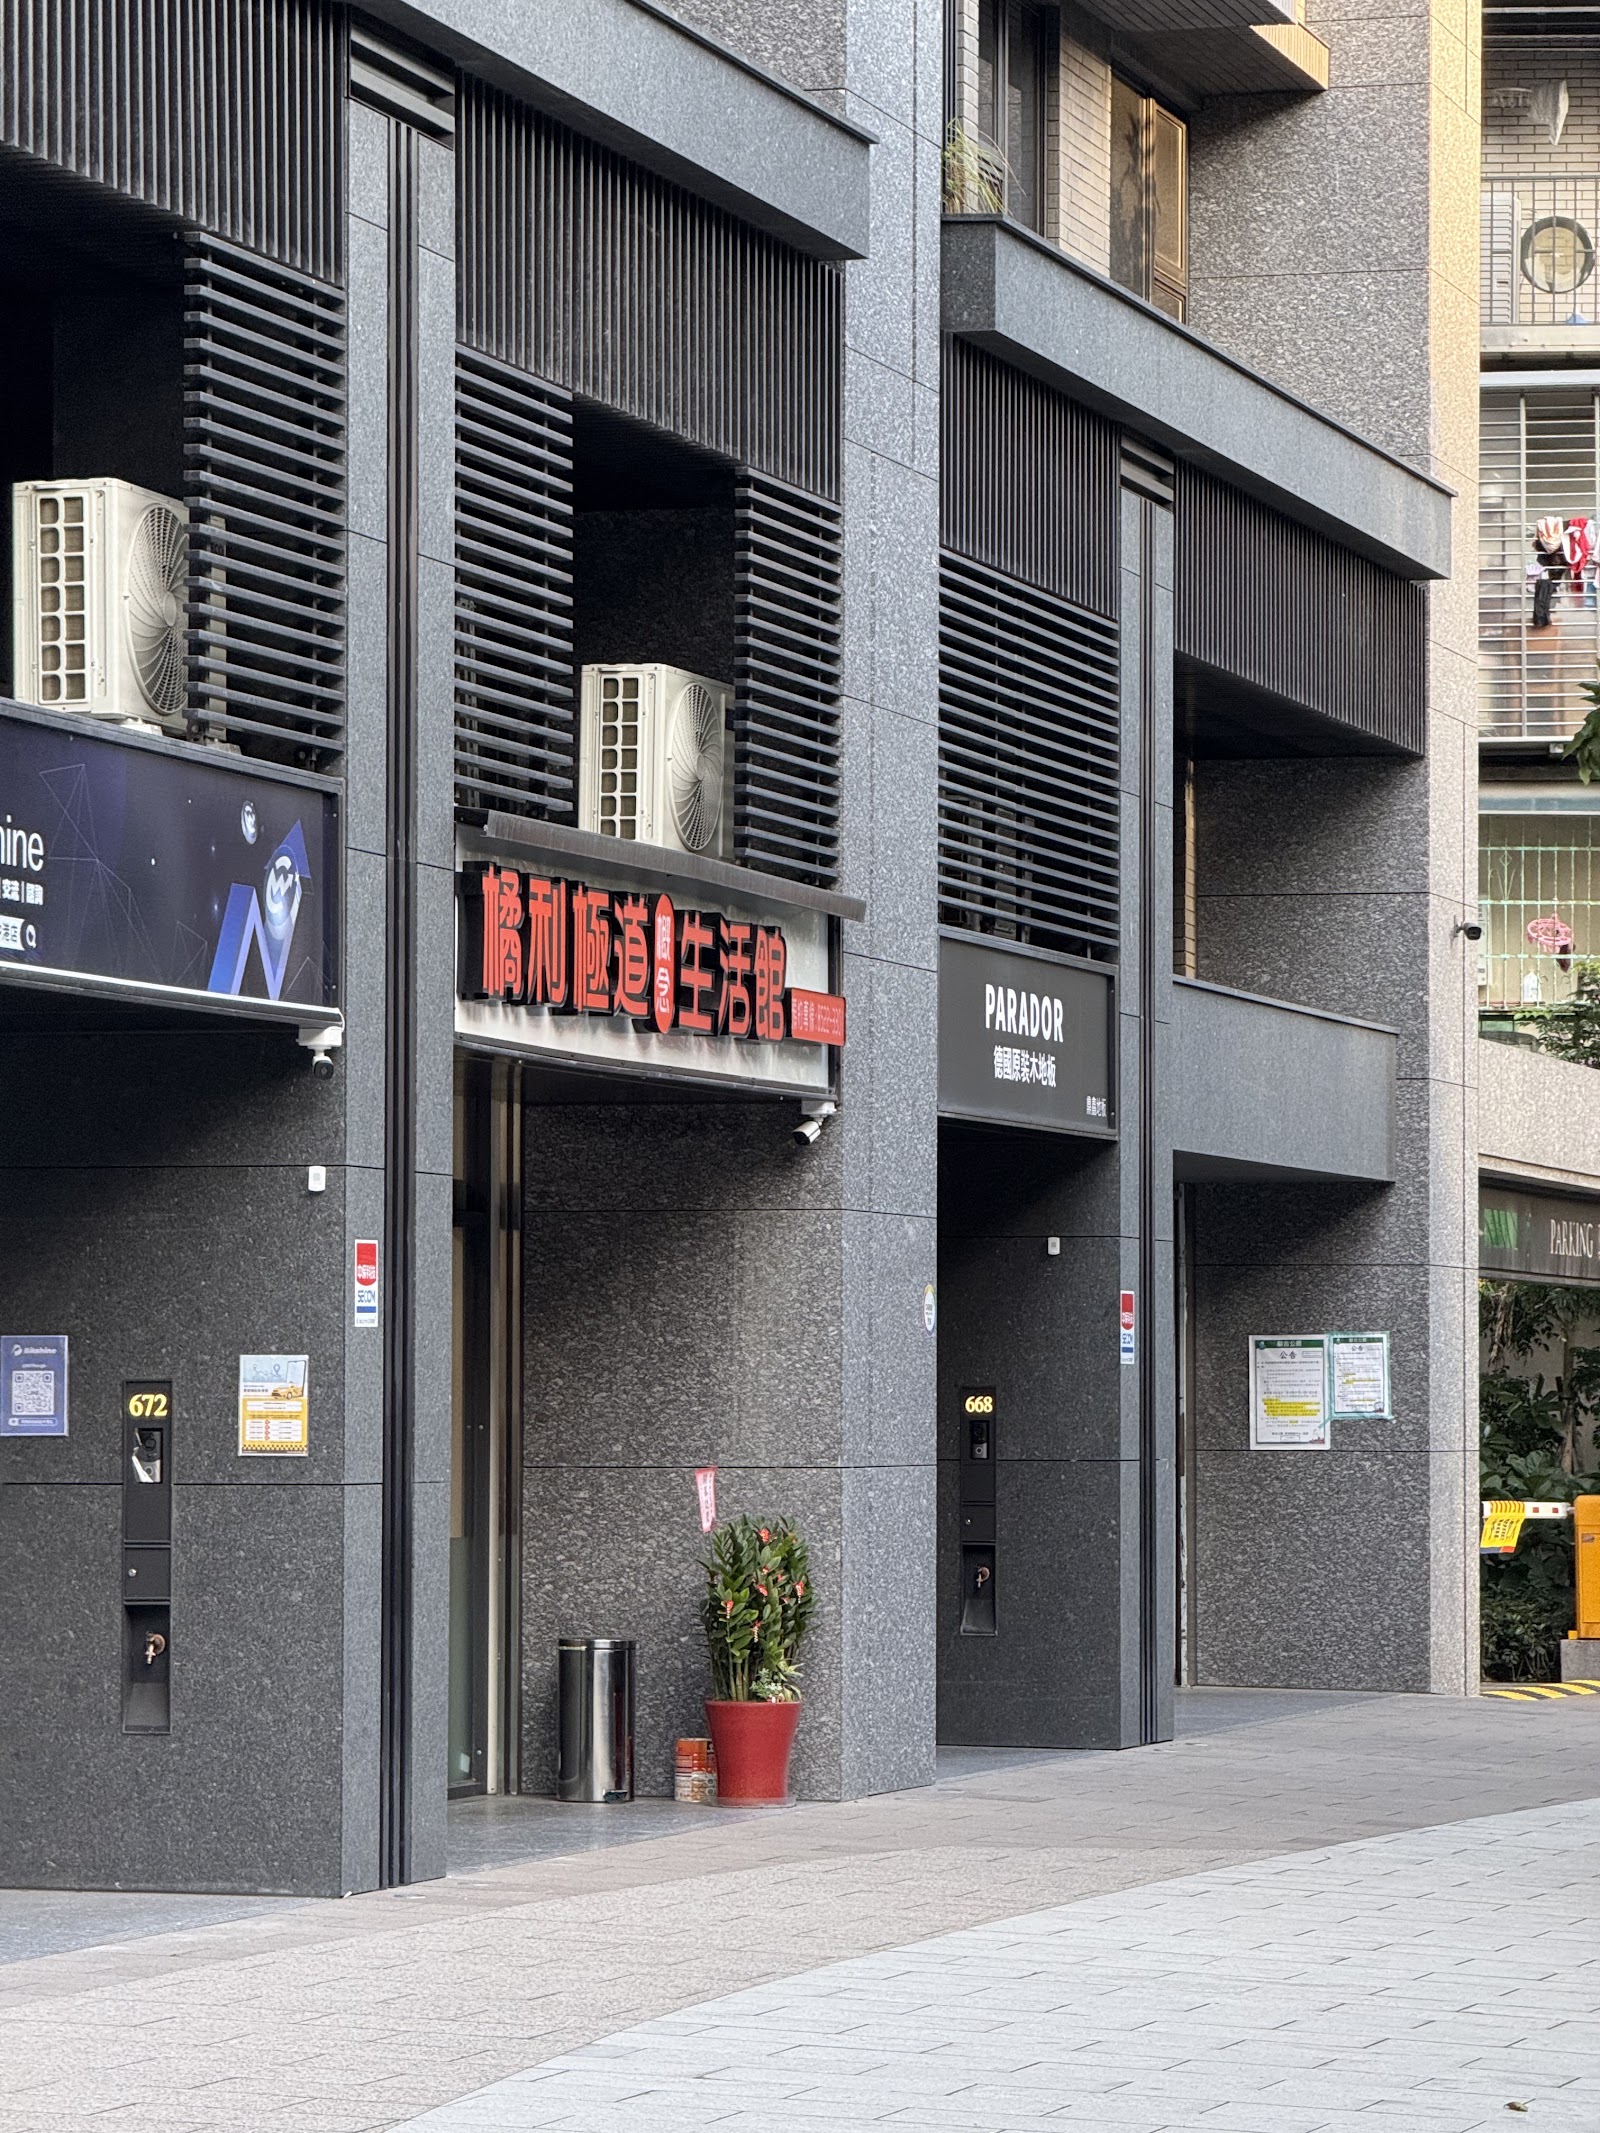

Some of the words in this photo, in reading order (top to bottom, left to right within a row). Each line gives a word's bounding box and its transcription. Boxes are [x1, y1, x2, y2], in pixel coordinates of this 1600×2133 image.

[482, 866, 649, 1016] 橘利極道
[679, 911, 786, 1040] 生活館
[985, 983, 1064, 1043] PARADOR
[993, 1044, 1057, 1088] 德國原裝木地板
[1550, 1218, 1594, 1259] PARKING
[1279, 1350, 1298, 1360] 公告
[128, 1393, 168, 1417] 672
[964, 1395, 993, 1413] 668
